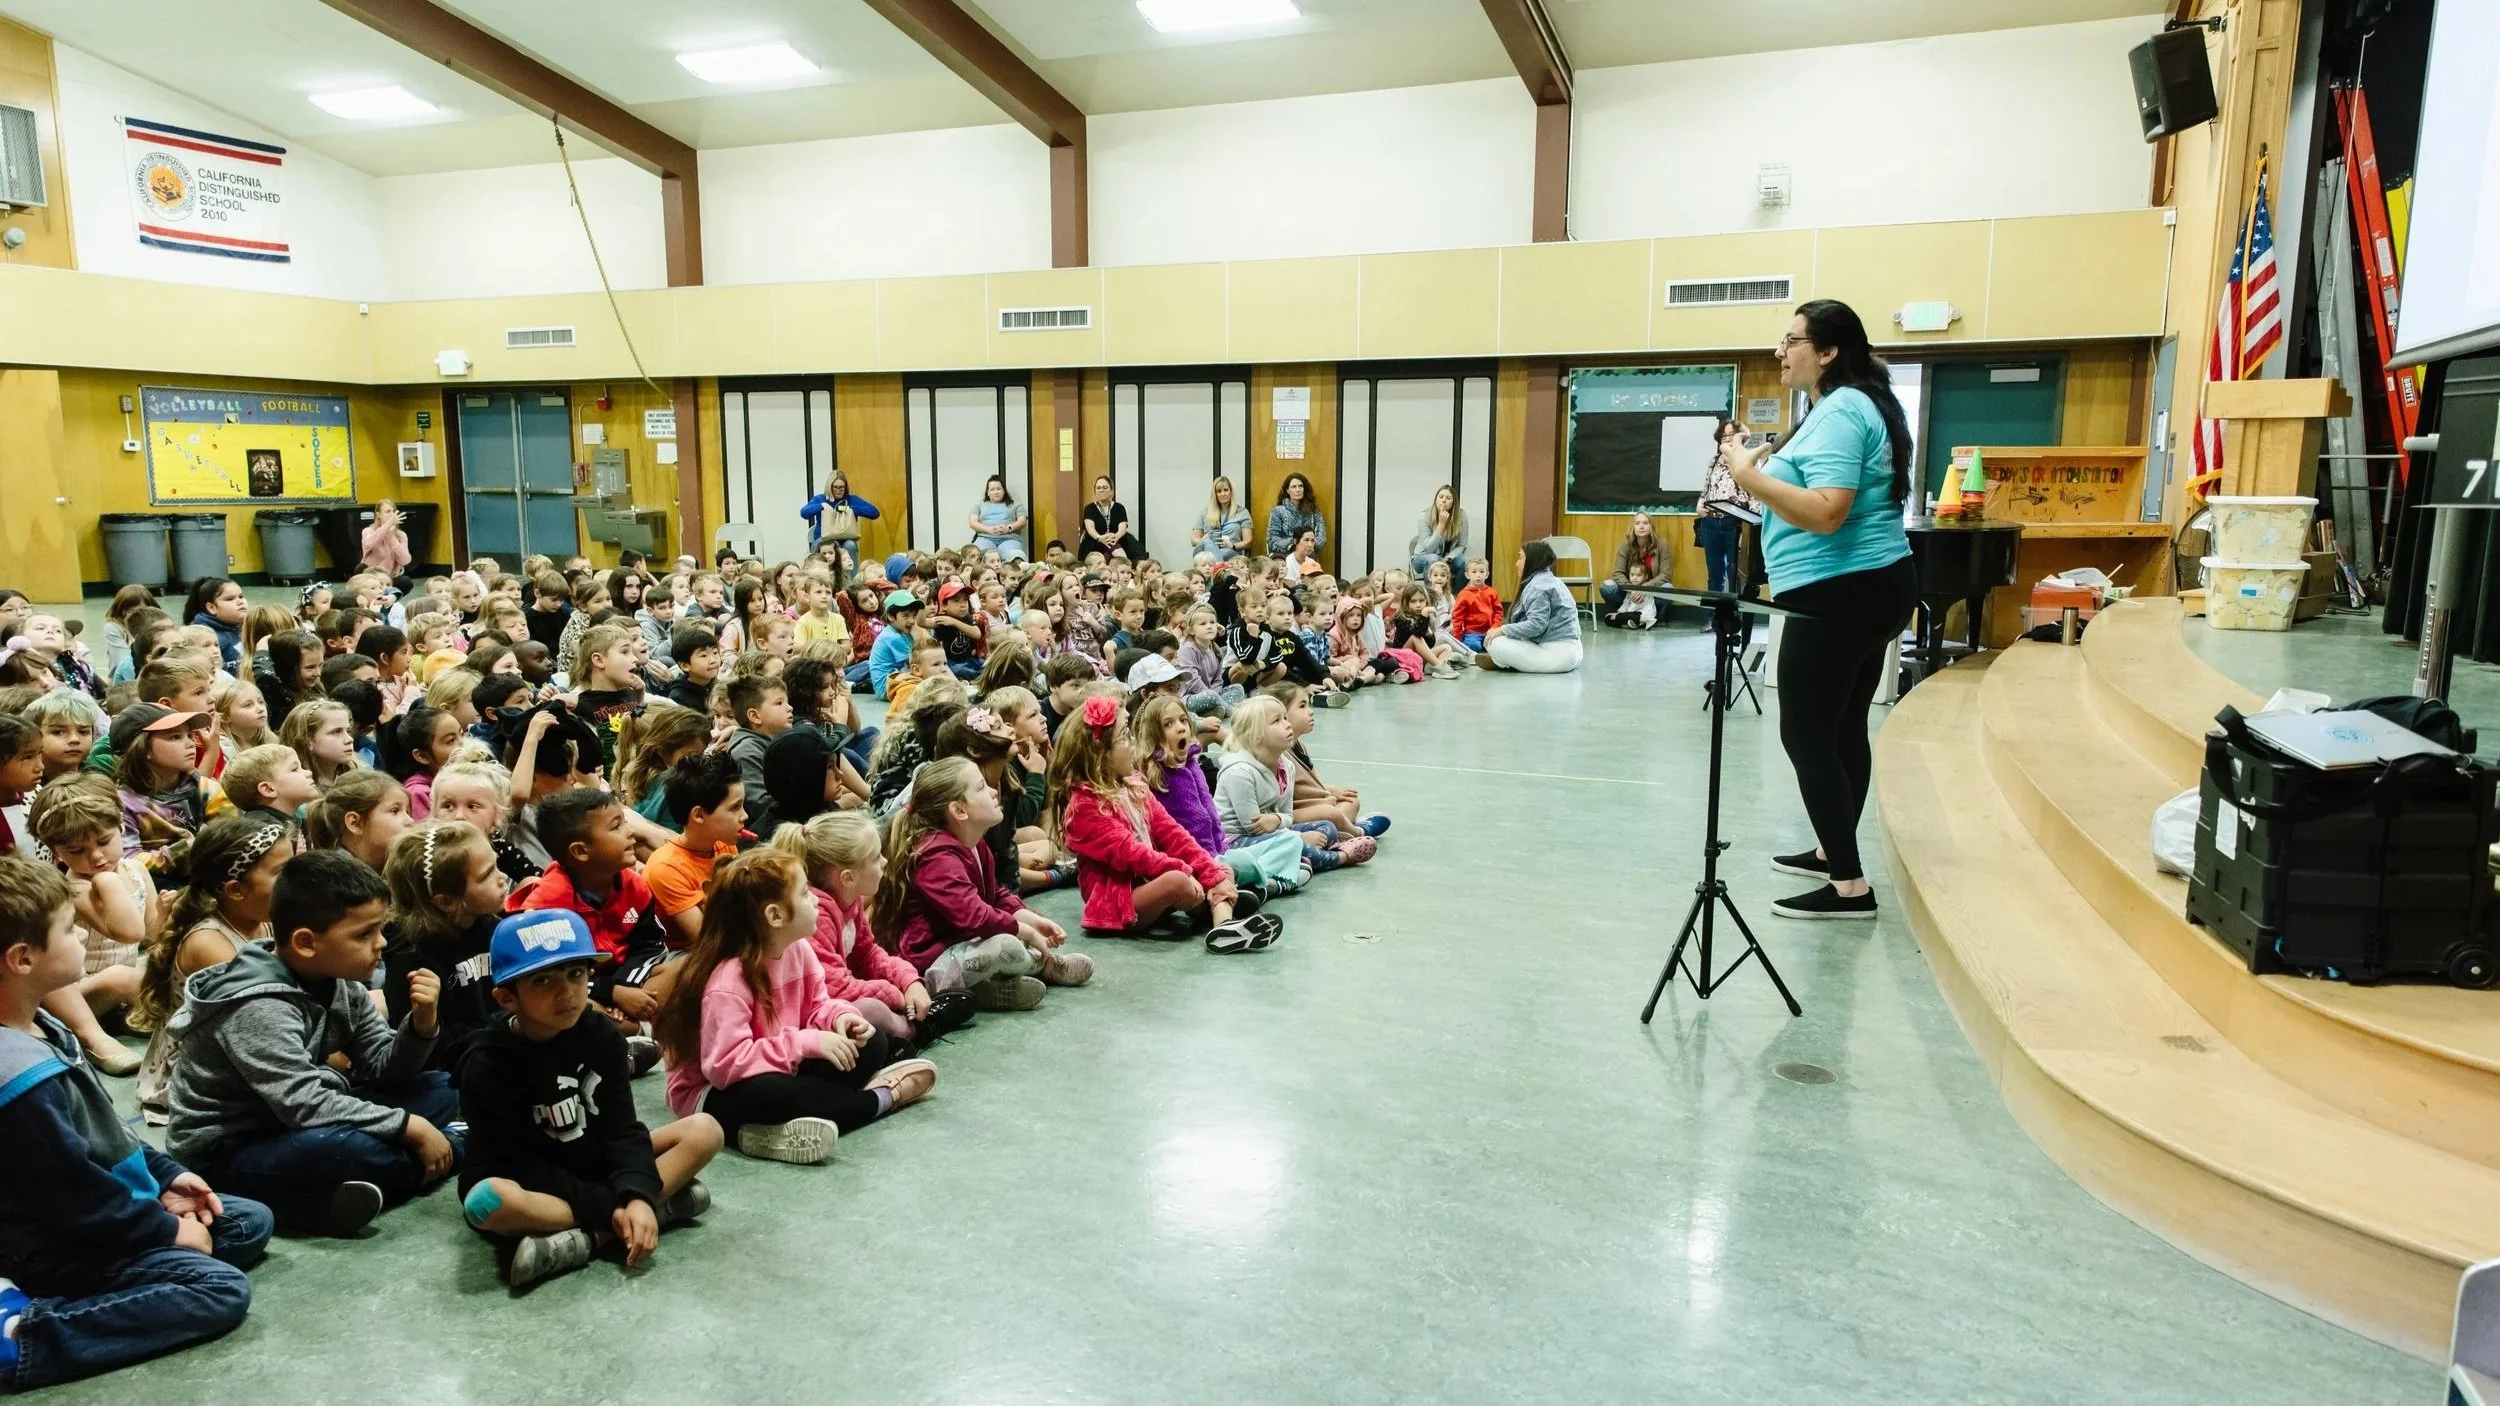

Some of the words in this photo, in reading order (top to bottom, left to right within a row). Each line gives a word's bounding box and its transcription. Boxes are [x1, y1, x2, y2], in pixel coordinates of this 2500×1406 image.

[137, 163, 155, 208] CALIFORNIA
[198, 168, 262, 188] CALIFORNIA
[199, 182, 281, 203] DISTINGUISHED
[200, 195, 246, 212] SCHOOL
[201, 209, 228, 221] 2010
[2403, 377, 2415, 404] BRUTE
[149, 398, 242, 415] VOLLEYBALL
[261, 400, 320, 414] FOOTBALL
[312, 427, 323, 489] SOCCER
[2462, 460, 2500, 498] 7
[455, 953, 492, 987] PUM
